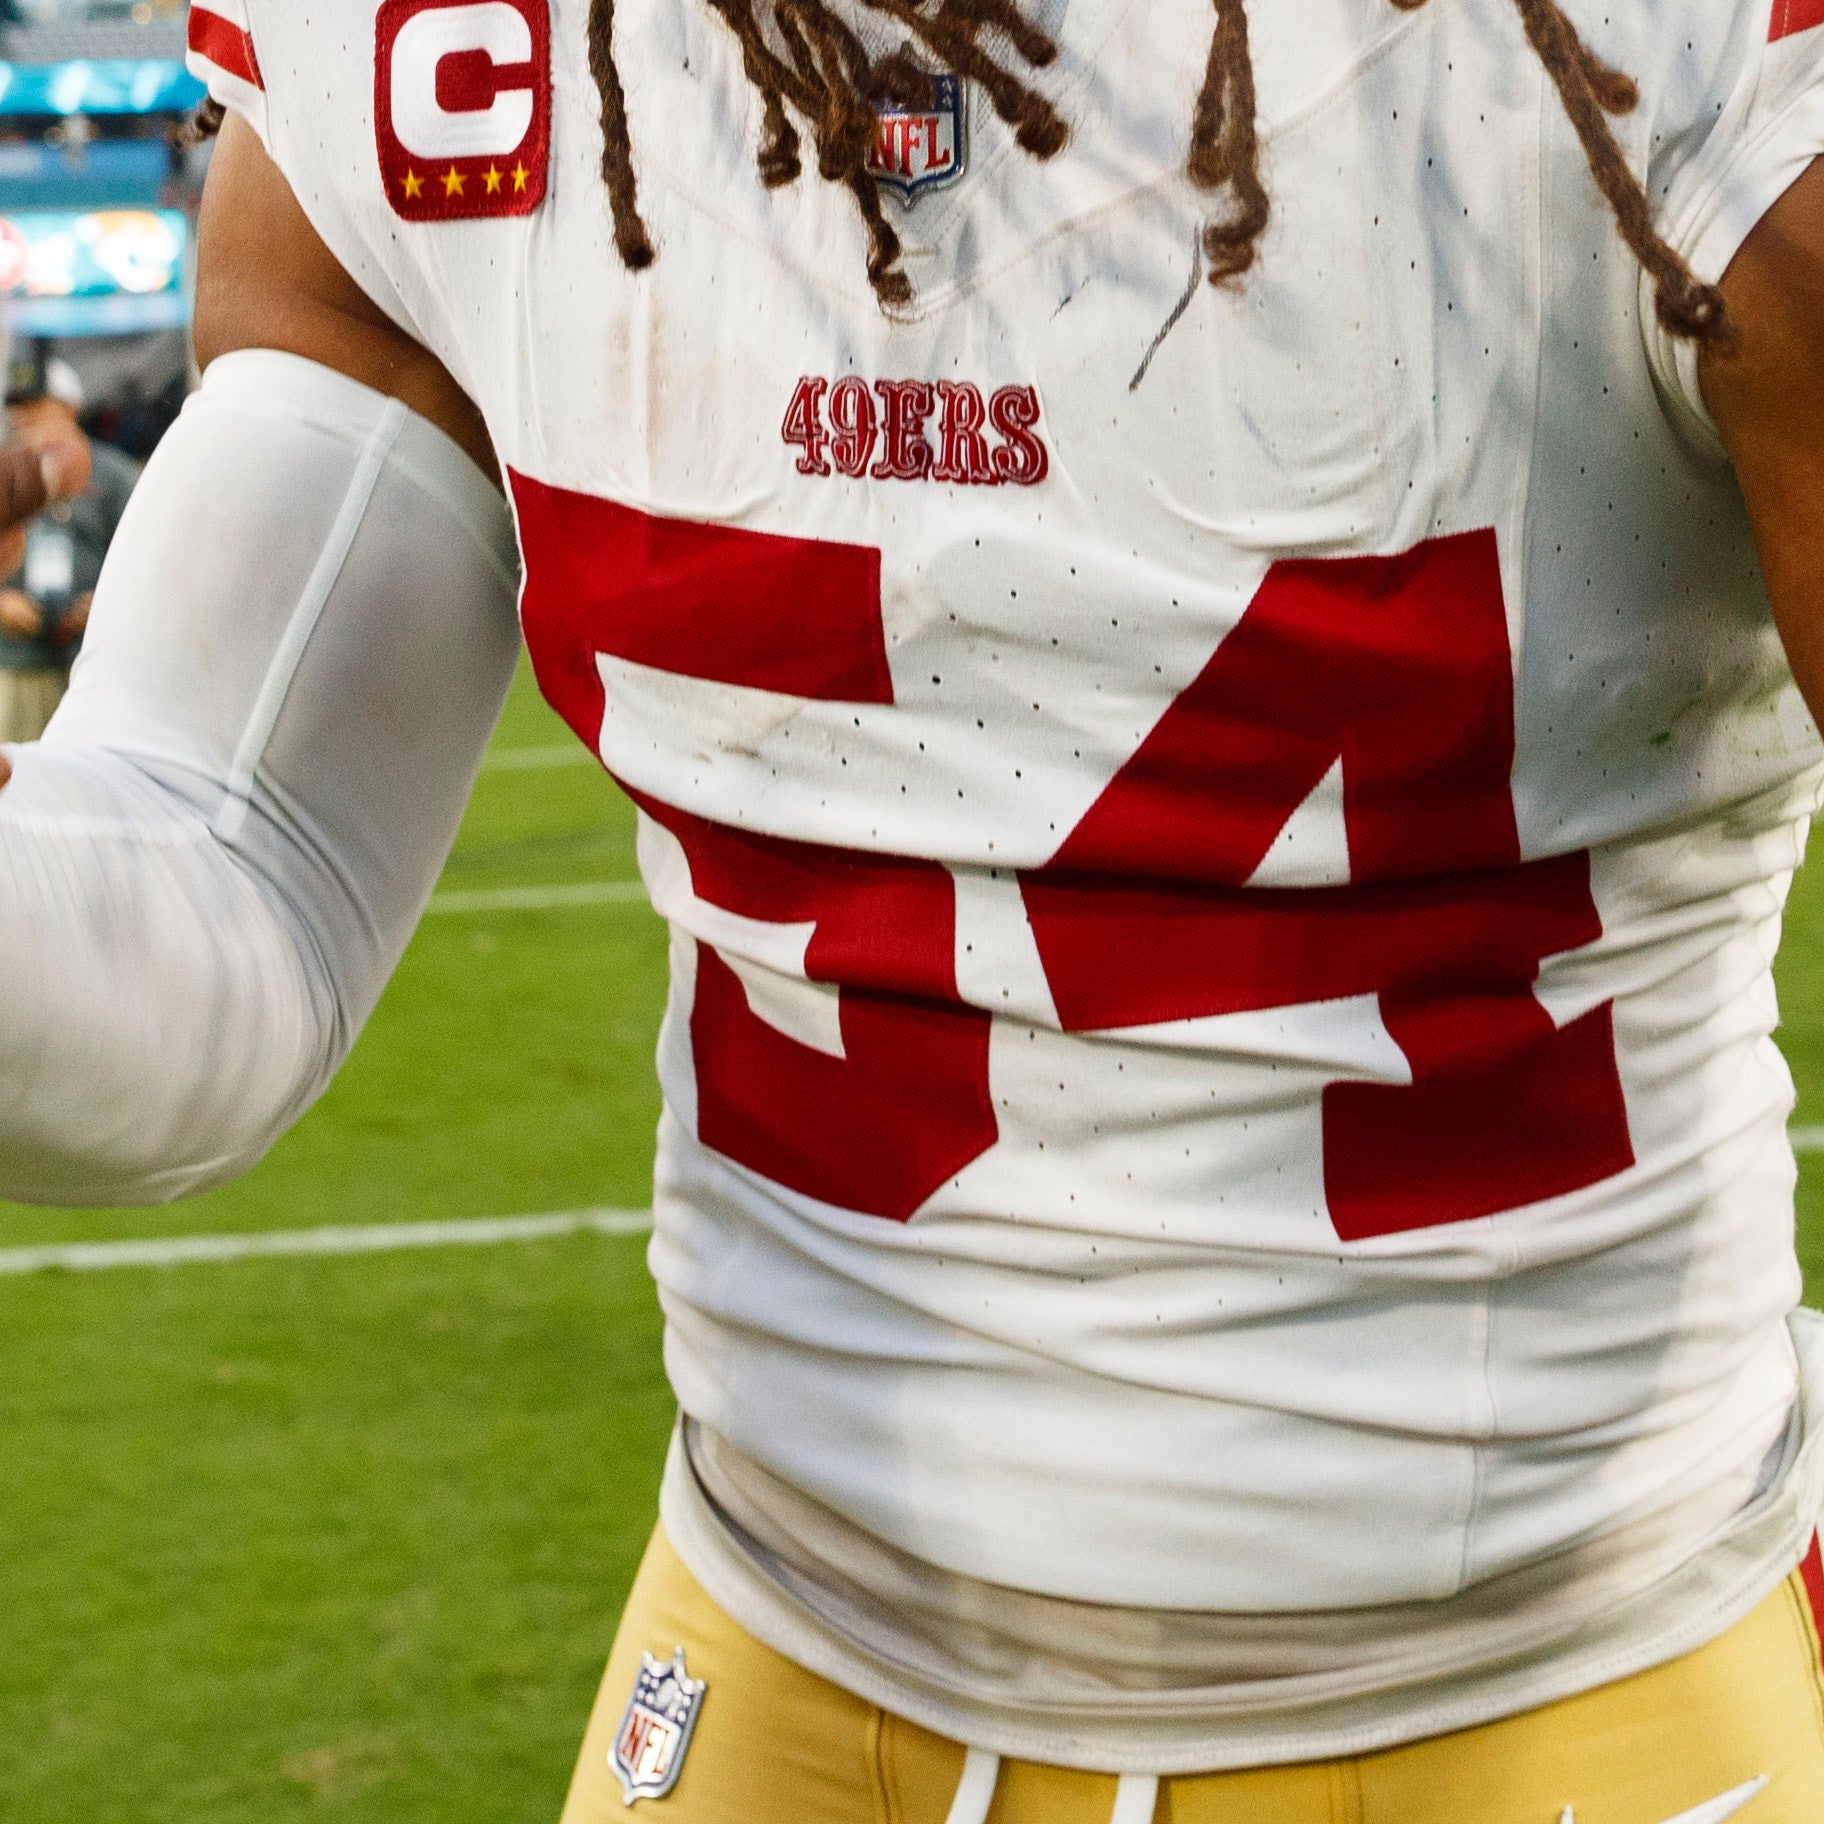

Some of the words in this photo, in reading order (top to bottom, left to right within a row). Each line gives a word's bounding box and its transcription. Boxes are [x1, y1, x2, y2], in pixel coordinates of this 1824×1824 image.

[390, 1, 533, 160] C
[868, 116, 951, 178] NFL
[781, 375, 1049, 486] 49ERS
[507, 463, 1635, 1242] 54
